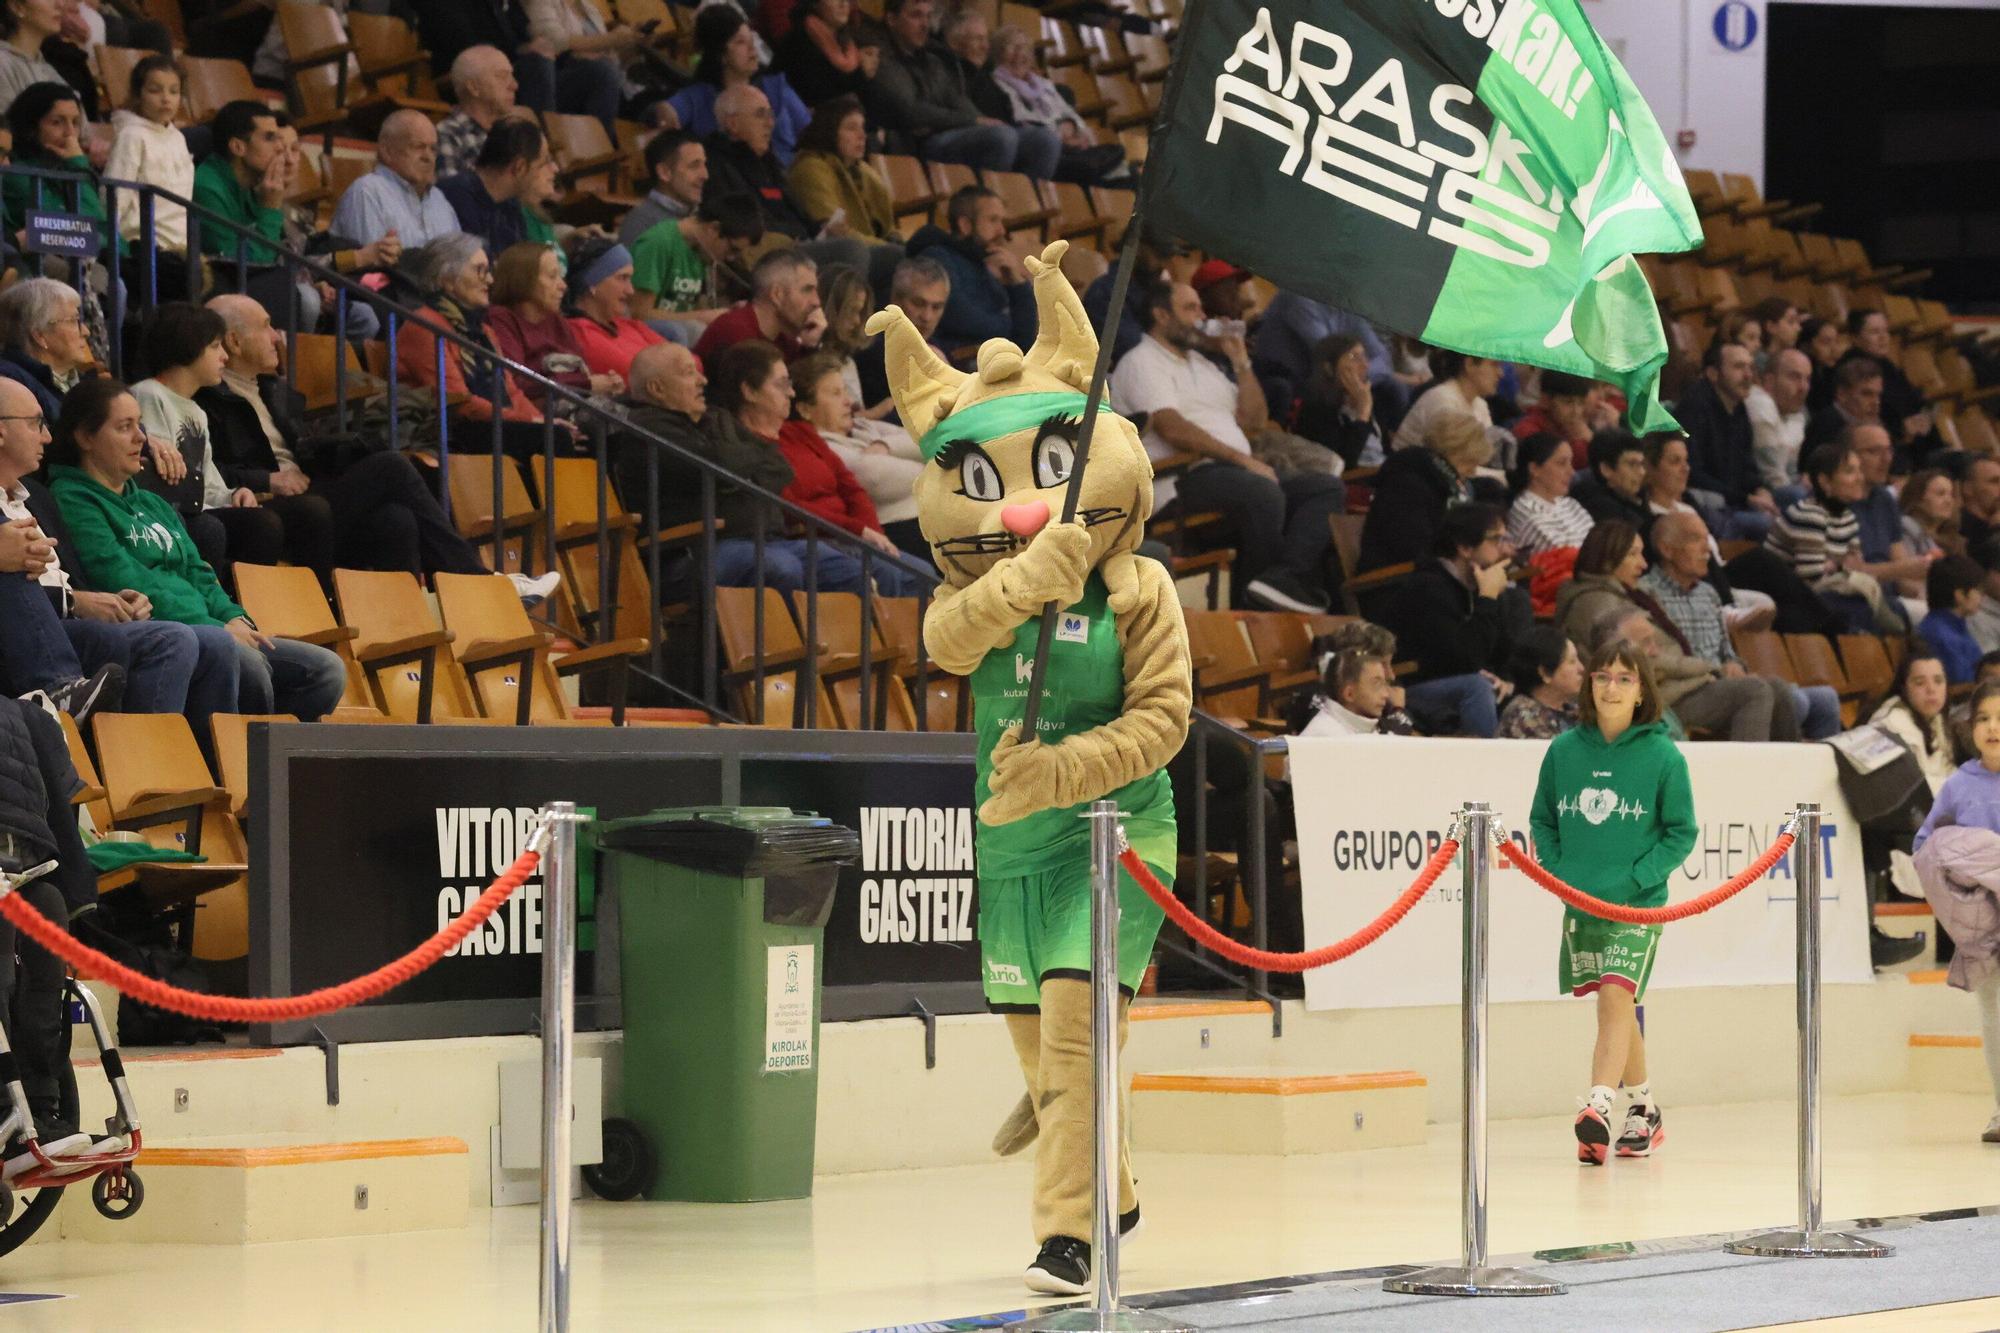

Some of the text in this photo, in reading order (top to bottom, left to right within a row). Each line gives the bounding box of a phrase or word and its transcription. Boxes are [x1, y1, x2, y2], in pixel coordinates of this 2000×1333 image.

[41, 233, 86, 248] RESERVADO
[860, 807, 974, 871] VITORIA
[860, 878, 973, 944] GASTEIZ
[772, 1040, 808, 1053] KIROLAK
[768, 1054, 810, 1068] DEPORTES
